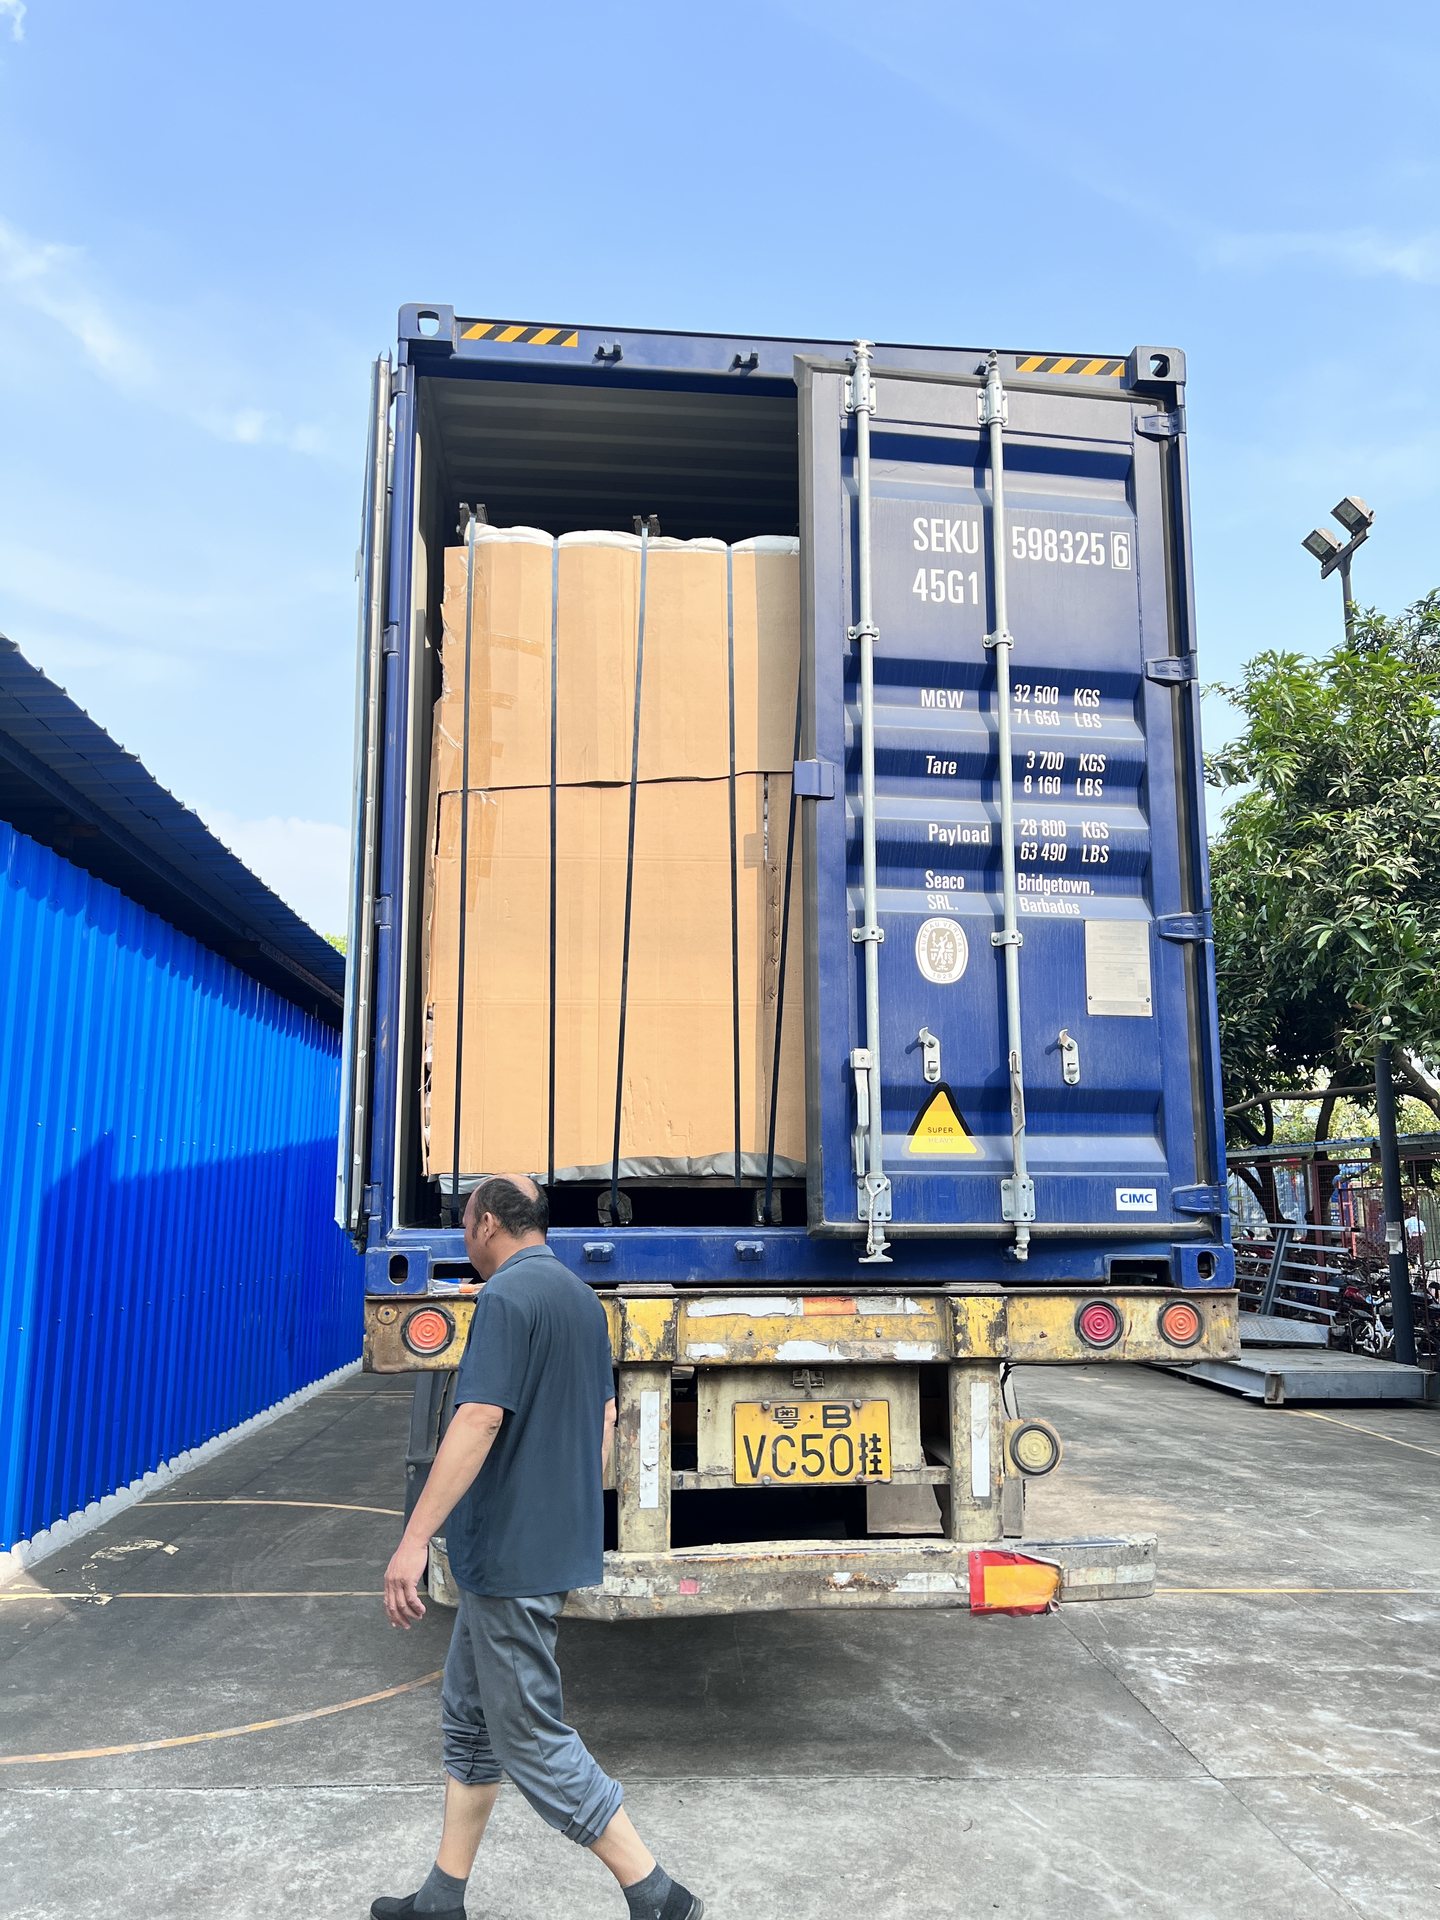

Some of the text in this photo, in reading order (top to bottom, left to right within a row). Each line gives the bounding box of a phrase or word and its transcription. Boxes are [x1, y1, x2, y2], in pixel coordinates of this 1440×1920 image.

[913, 517, 1131, 570] SEKU 598325 6
[912, 568, 979, 605] 45G1
[921, 684, 1100, 708] MGW 32 500 KGS
[1075, 712, 1102, 728] LBS
[926, 755, 957, 775] Tare
[1079, 753, 1106, 772] KGS
[1076, 778, 1103, 797] LBS
[928, 823, 990, 846] Payload
[1082, 821, 1109, 839] KGS
[1081, 845, 1109, 863] LBS
[925, 870, 1095, 896] Seaco Bridgetown,
[927, 894, 1080, 915] SRL. Barbados
[927, 1126, 954, 1134] SUPER
[1120, 1193, 1153, 1204] CIMC
